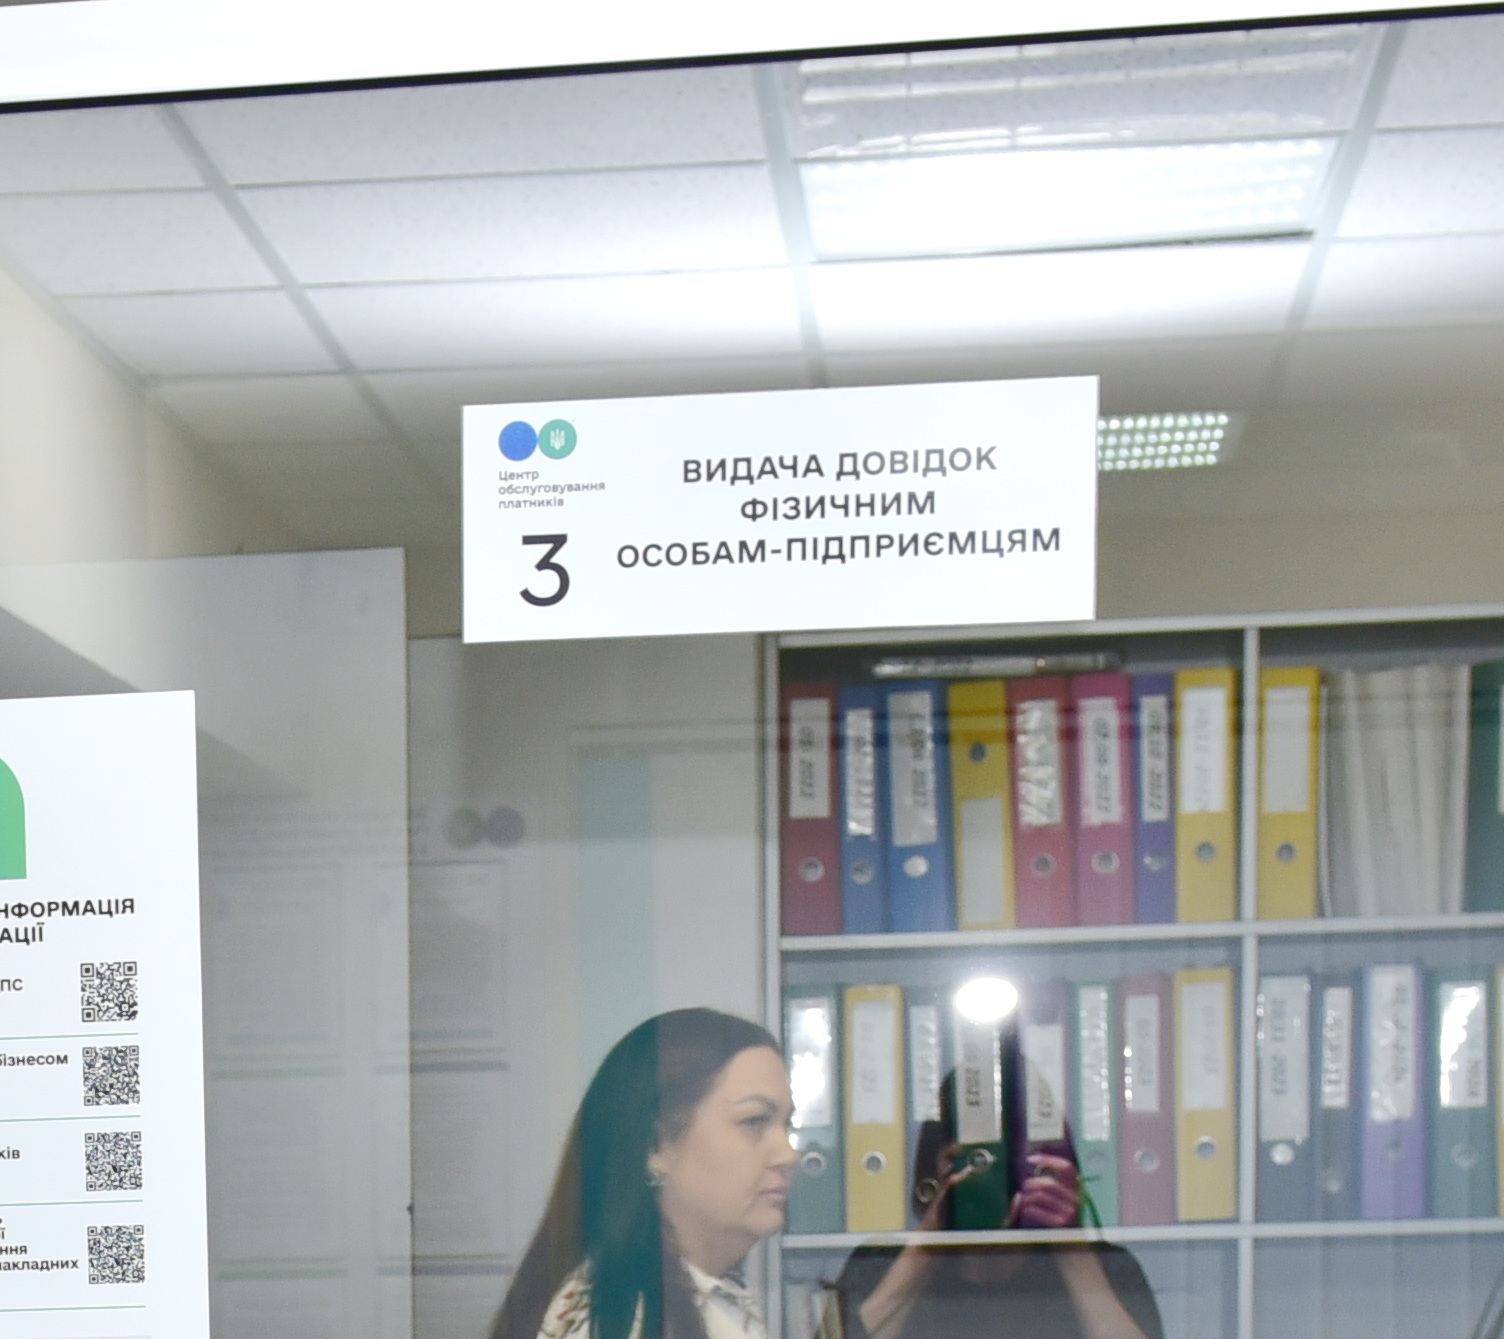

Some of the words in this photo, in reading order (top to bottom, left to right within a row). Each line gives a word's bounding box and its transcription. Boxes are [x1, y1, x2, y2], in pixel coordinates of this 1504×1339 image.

[499, 469, 540, 483] Центр
[683, 454, 825, 486] ВИДАЧА
[835, 446, 996, 482] ДОВІДОК
[498, 482, 606, 496] обслуговування
[498, 497, 564, 509] платників
[740, 491, 935, 522] ФІЗИЧНИМ
[617, 527, 1060, 569] ОСОБАМ-ПІДПРИЄМЦЯМ
[520, 533, 570, 607] 3
